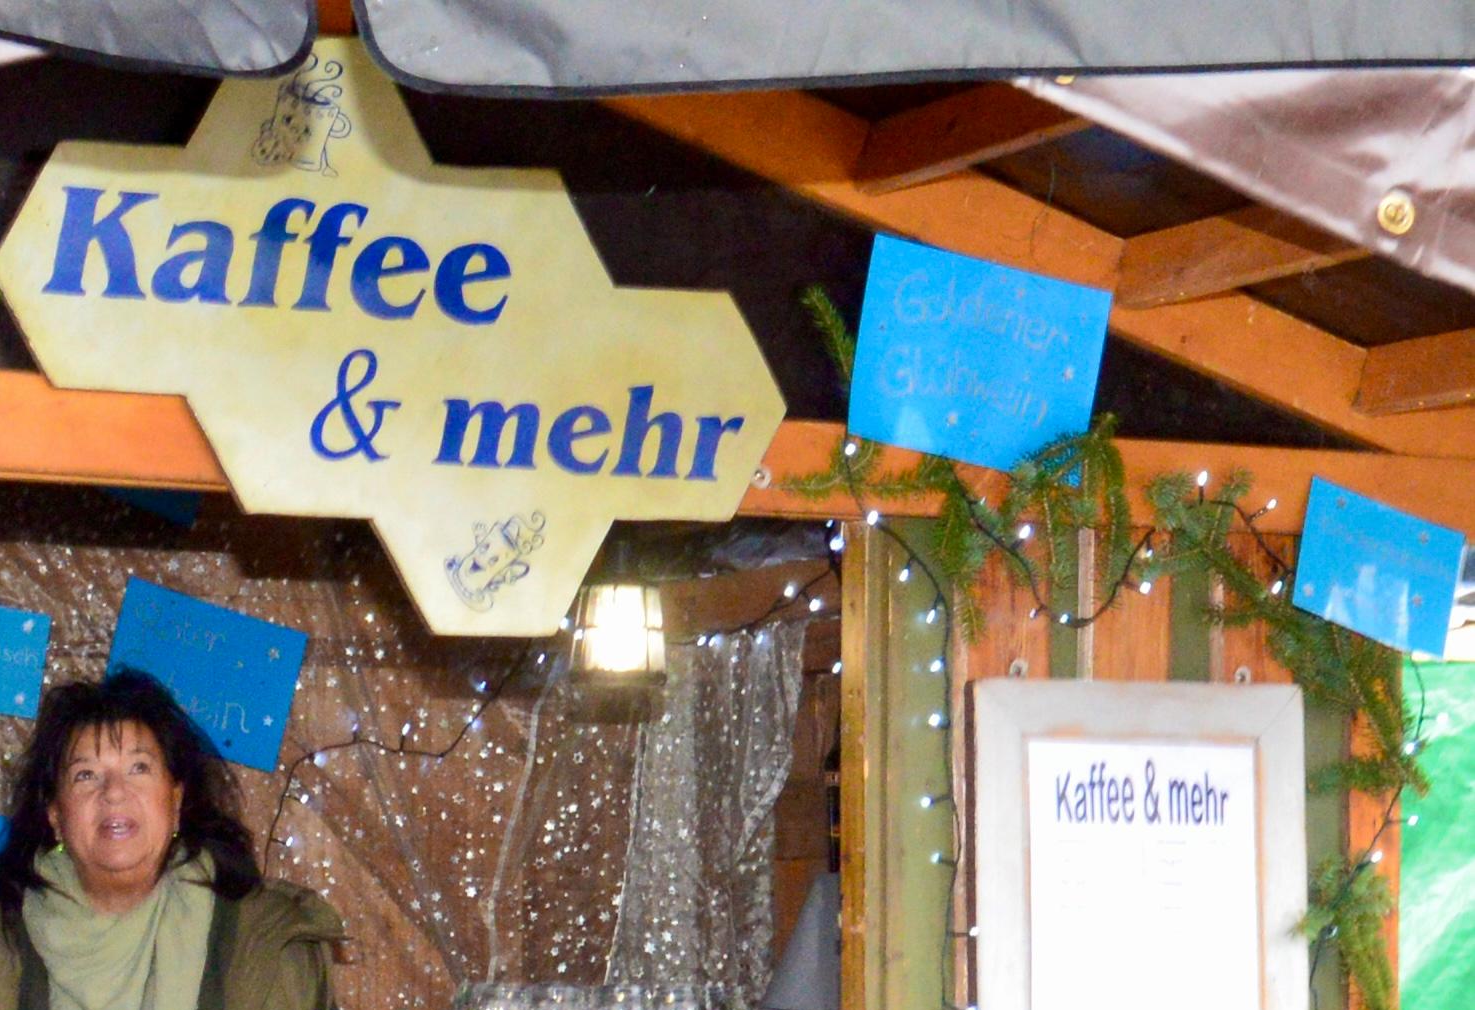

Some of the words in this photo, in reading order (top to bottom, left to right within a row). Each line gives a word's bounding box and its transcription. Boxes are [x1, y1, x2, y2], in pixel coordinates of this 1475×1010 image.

[42, 185, 512, 326] Kaffee
[308, 348, 401, 463] &
[434, 384, 745, 483] mehr
[1056, 761, 1135, 823] Kaffee
[1144, 758, 1161, 824] &
[1169, 771, 1228, 826] mehr
